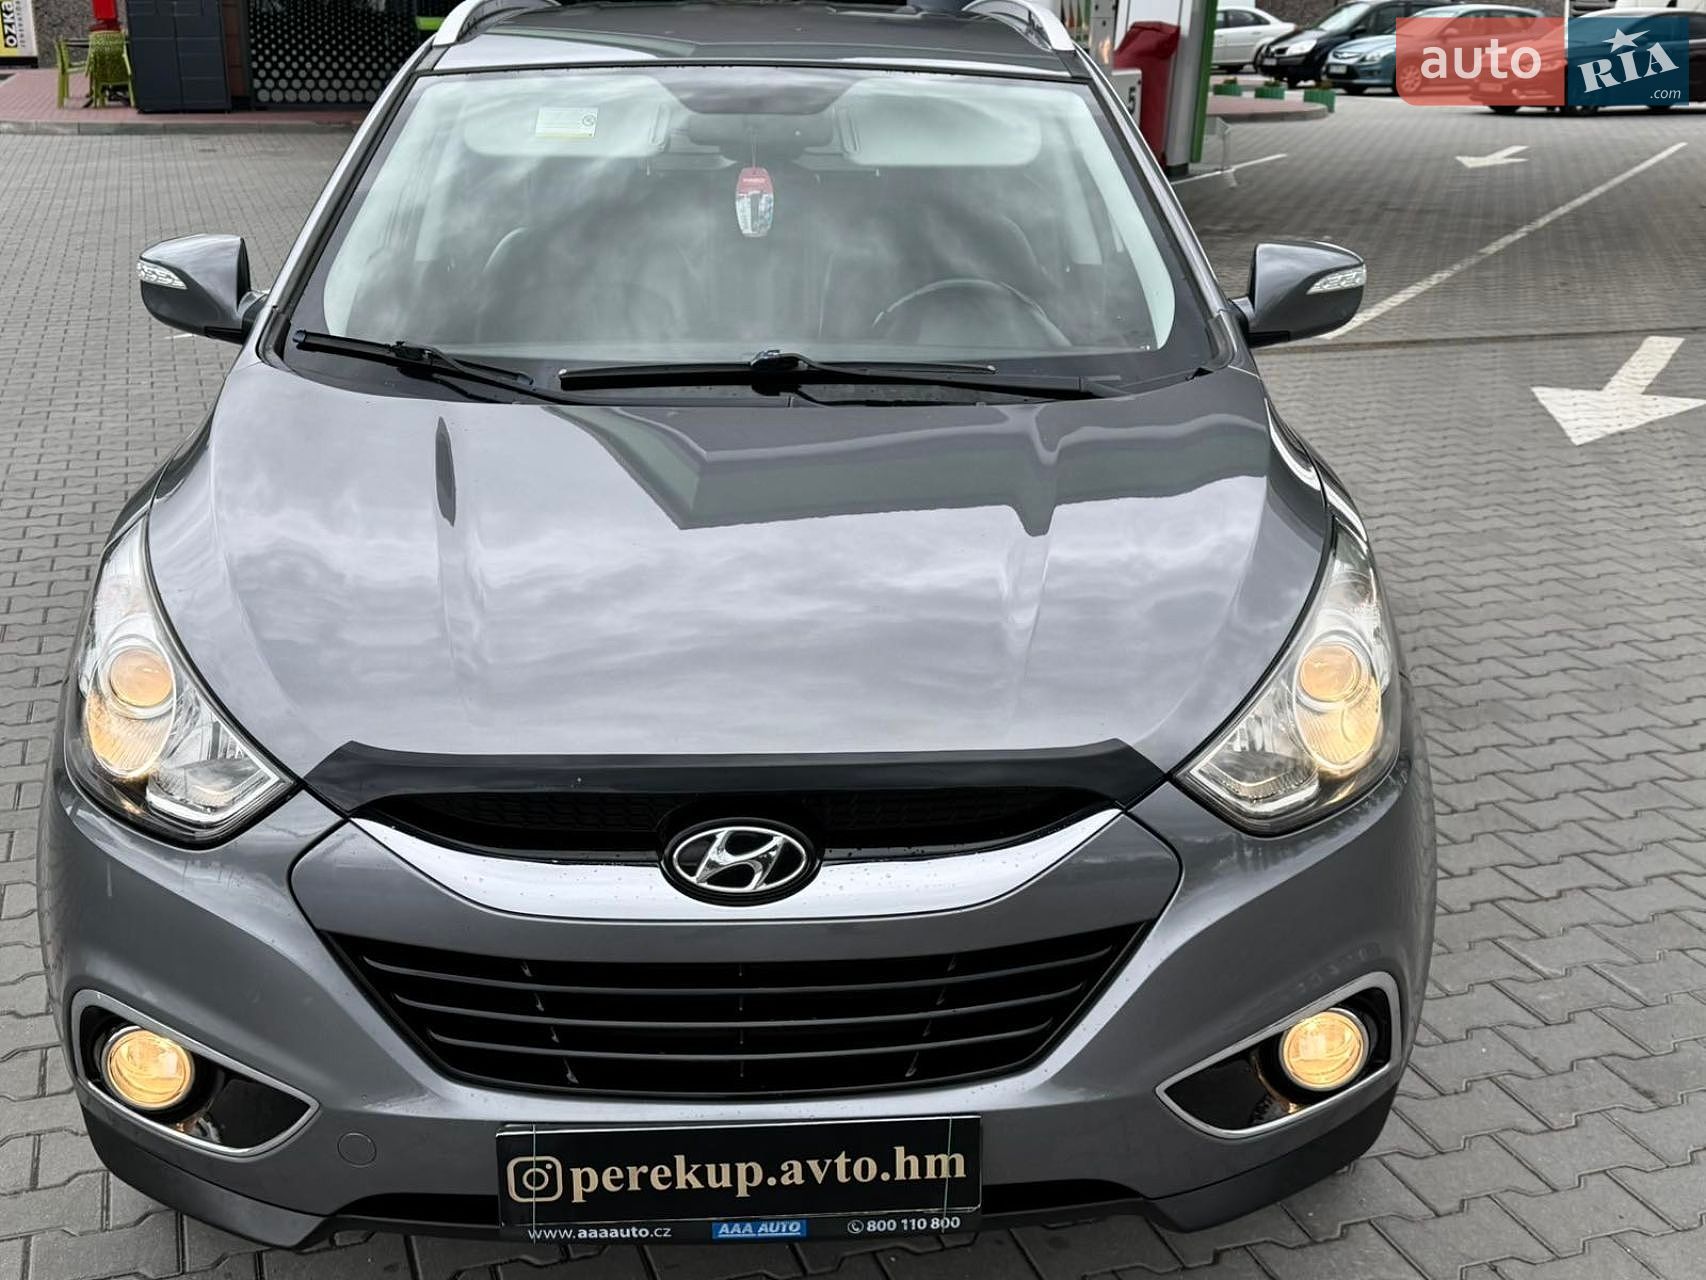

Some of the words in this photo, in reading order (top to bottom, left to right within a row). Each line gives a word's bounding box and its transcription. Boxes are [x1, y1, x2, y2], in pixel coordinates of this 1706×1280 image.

[569, 1145, 967, 1203] perekup.avto.hm
[717, 1222, 754, 1236] AAA
[757, 1221, 801, 1235] AUTO
[866, 1219, 897, 1232] 800
[900, 1217, 927, 1231] 110
[930, 1216, 961, 1230] 800
[528, 1226, 672, 1240] www.aaaauto.cz
